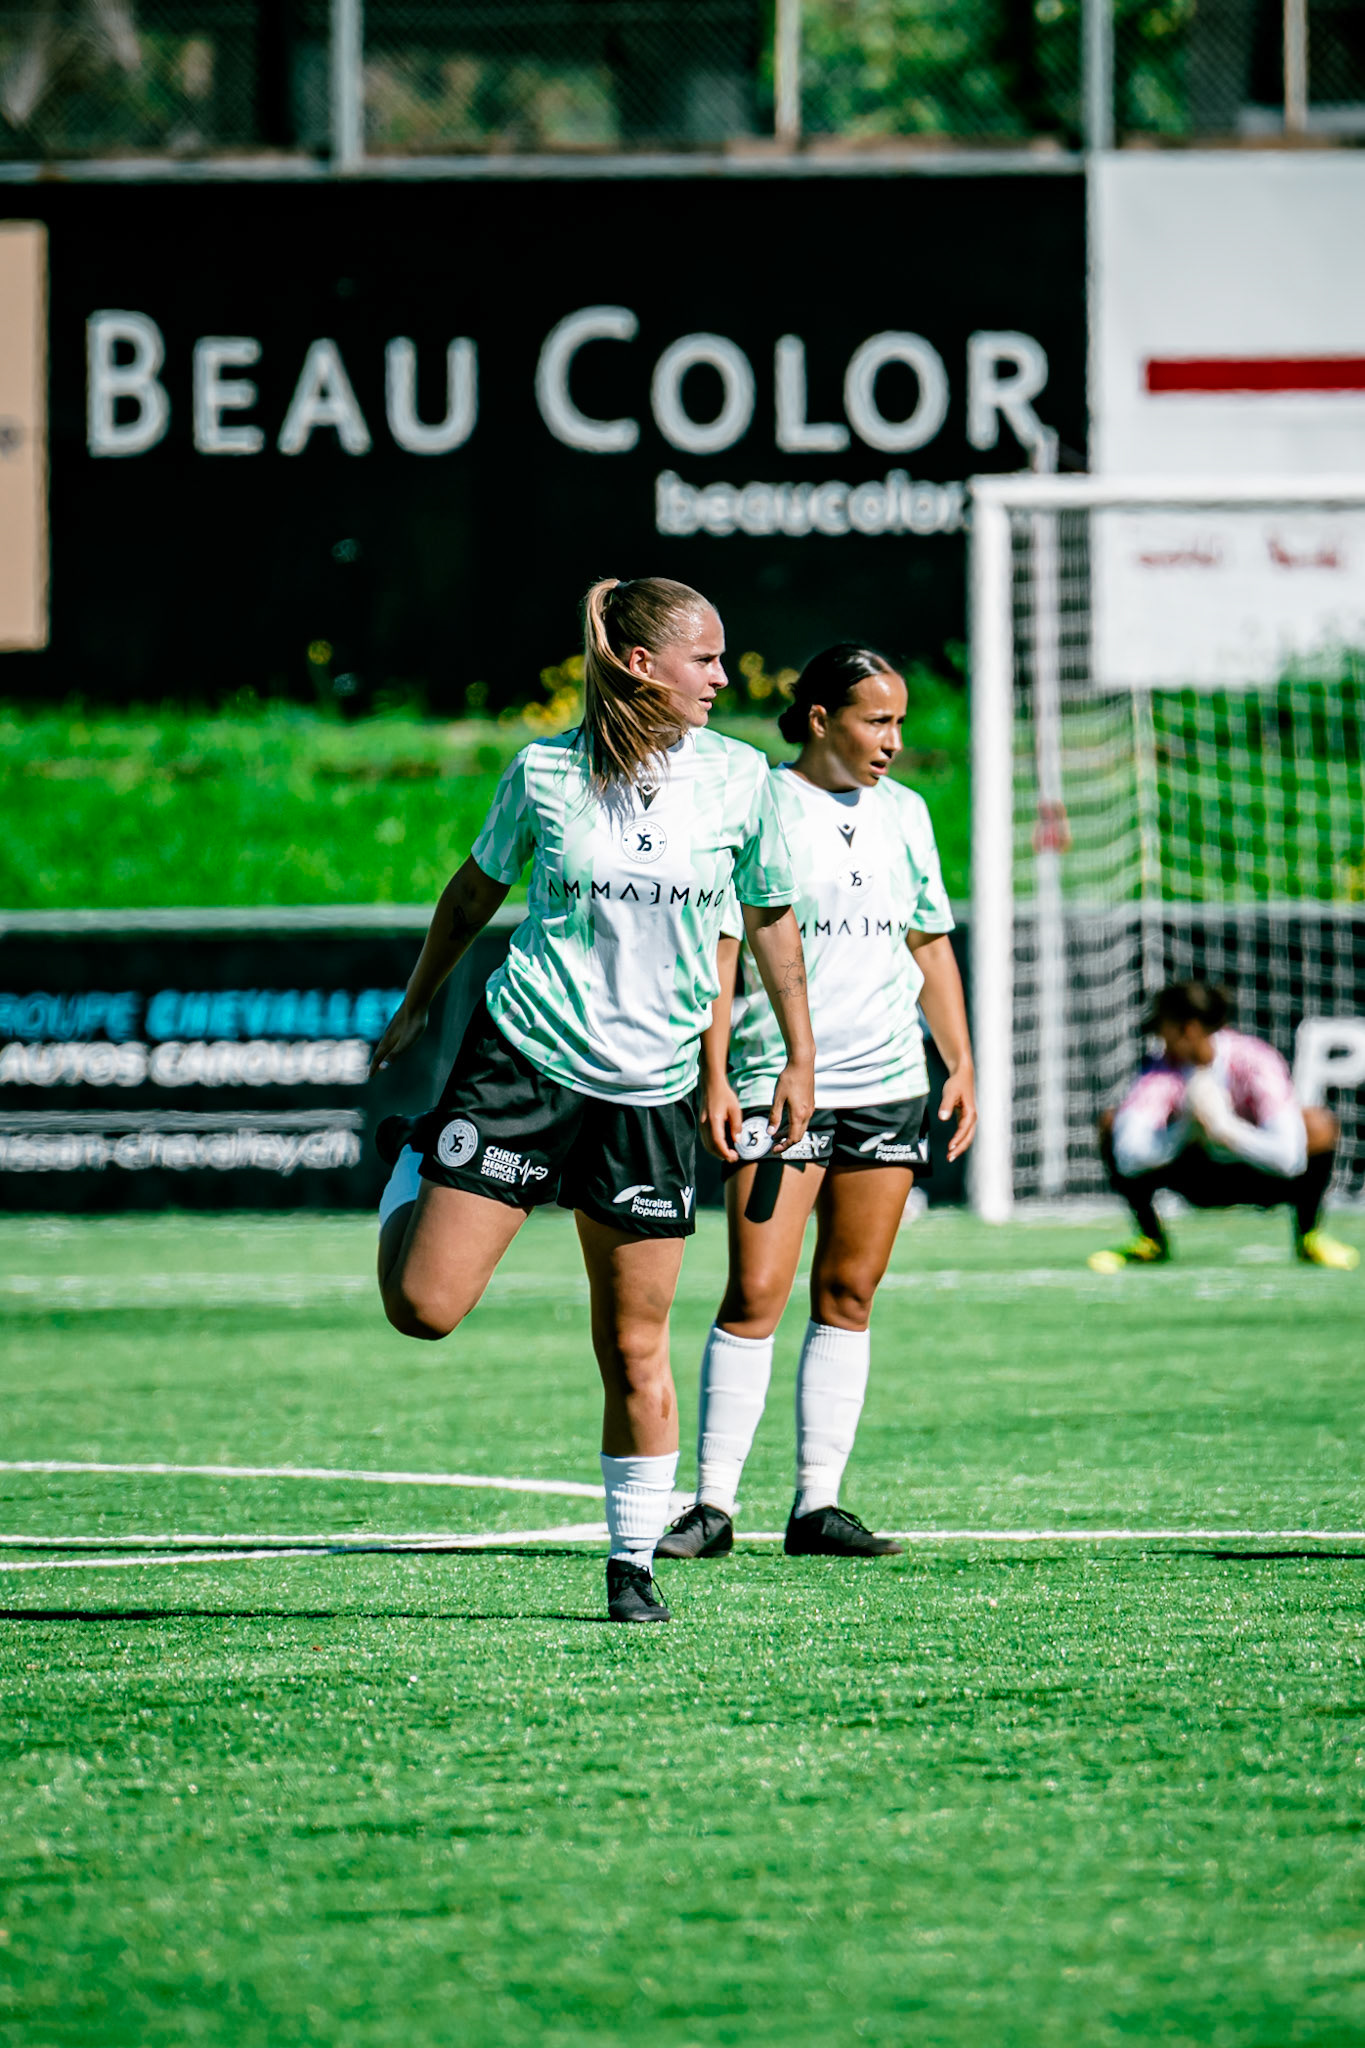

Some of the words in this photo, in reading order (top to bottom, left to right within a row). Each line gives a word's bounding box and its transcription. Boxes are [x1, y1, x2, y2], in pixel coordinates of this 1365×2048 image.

[86, 309, 478, 457] BEAU
[535, 305, 1049, 454] COLOR
[485, 1145, 522, 1165] CHRIS
[480, 1166, 515, 1184] SERVICES
[482, 1158, 517, 1176] MEDICAL
[631, 1203, 678, 1218] Populaires
[633, 1195, 672, 1209] Retraites
